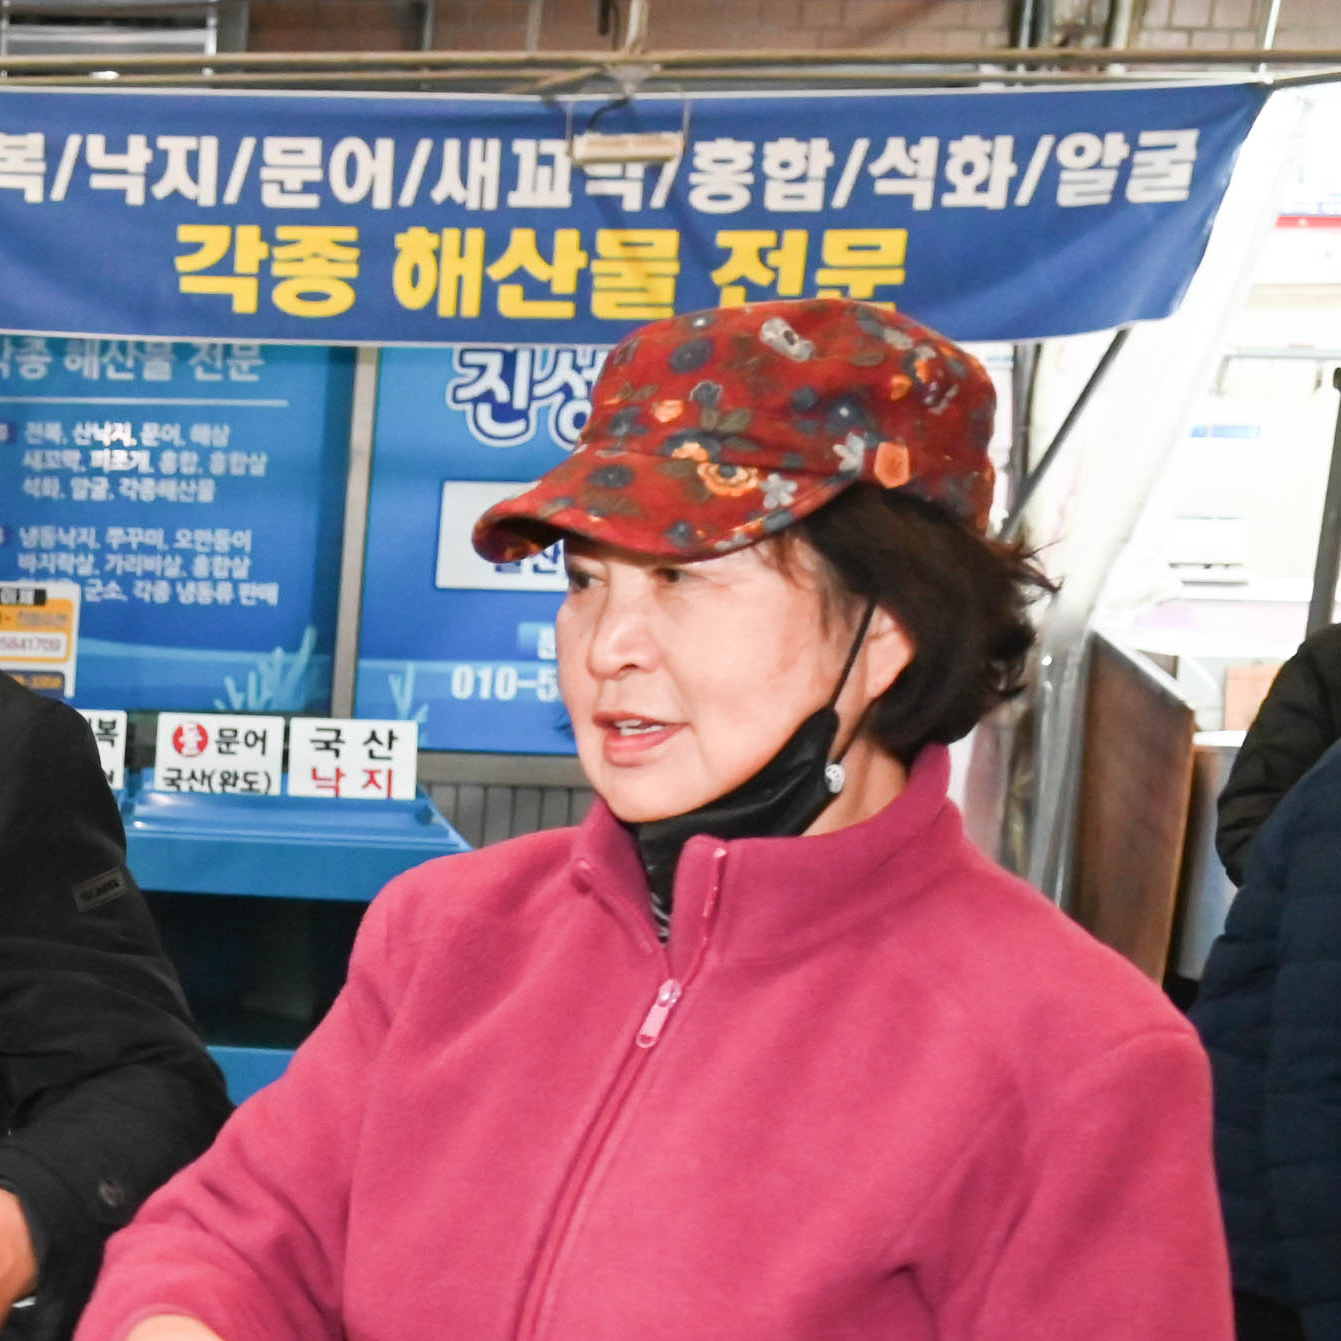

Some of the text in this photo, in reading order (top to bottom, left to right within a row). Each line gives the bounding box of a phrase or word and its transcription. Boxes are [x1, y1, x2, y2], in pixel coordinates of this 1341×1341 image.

[174, 223, 908, 319] 각종 해산물 전문
[64, 338, 176, 381] 해산물
[189, 340, 264, 382] 전문
[133, 581, 170, 604] 각종
[239, 582, 279, 607] 판매
[87, 718, 118, 749] 복
